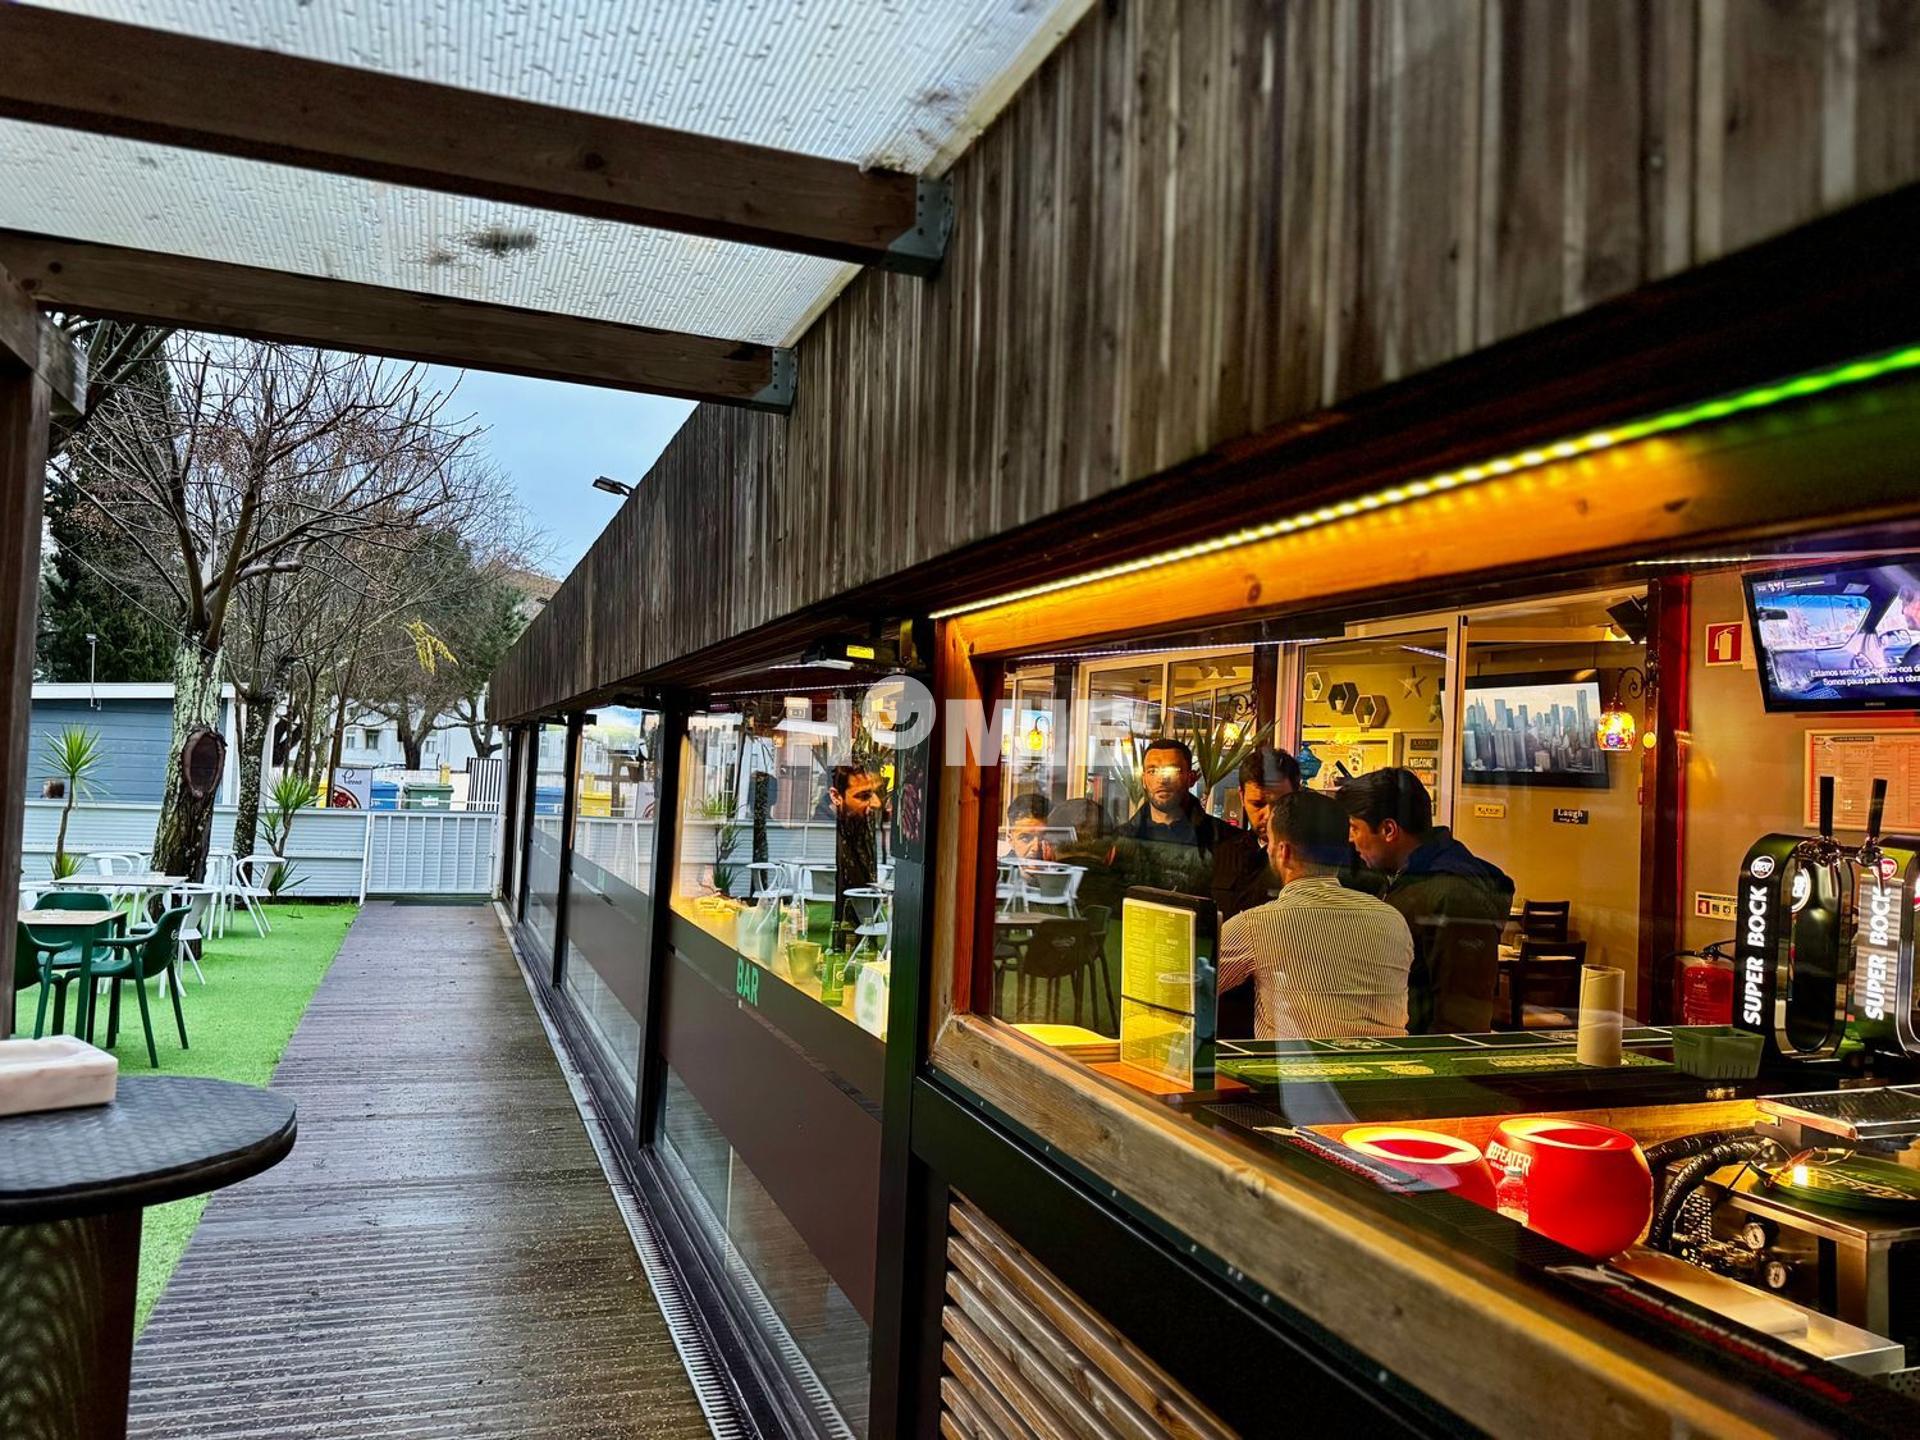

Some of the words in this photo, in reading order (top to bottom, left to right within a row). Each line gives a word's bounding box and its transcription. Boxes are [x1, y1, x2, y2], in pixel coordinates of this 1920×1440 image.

[1823, 678, 1846, 686] Somos
[1865, 677, 1881, 686] para
[1410, 758, 1433, 768] WELCOME
[1558, 808, 1583, 819] Laugh
[1747, 885, 1768, 947] BOCK
[1869, 886, 1891, 947] BOCK
[736, 957, 759, 1007] BAR
[1743, 955, 1765, 1026] SUPER
[1865, 954, 1888, 1021] SUPER
